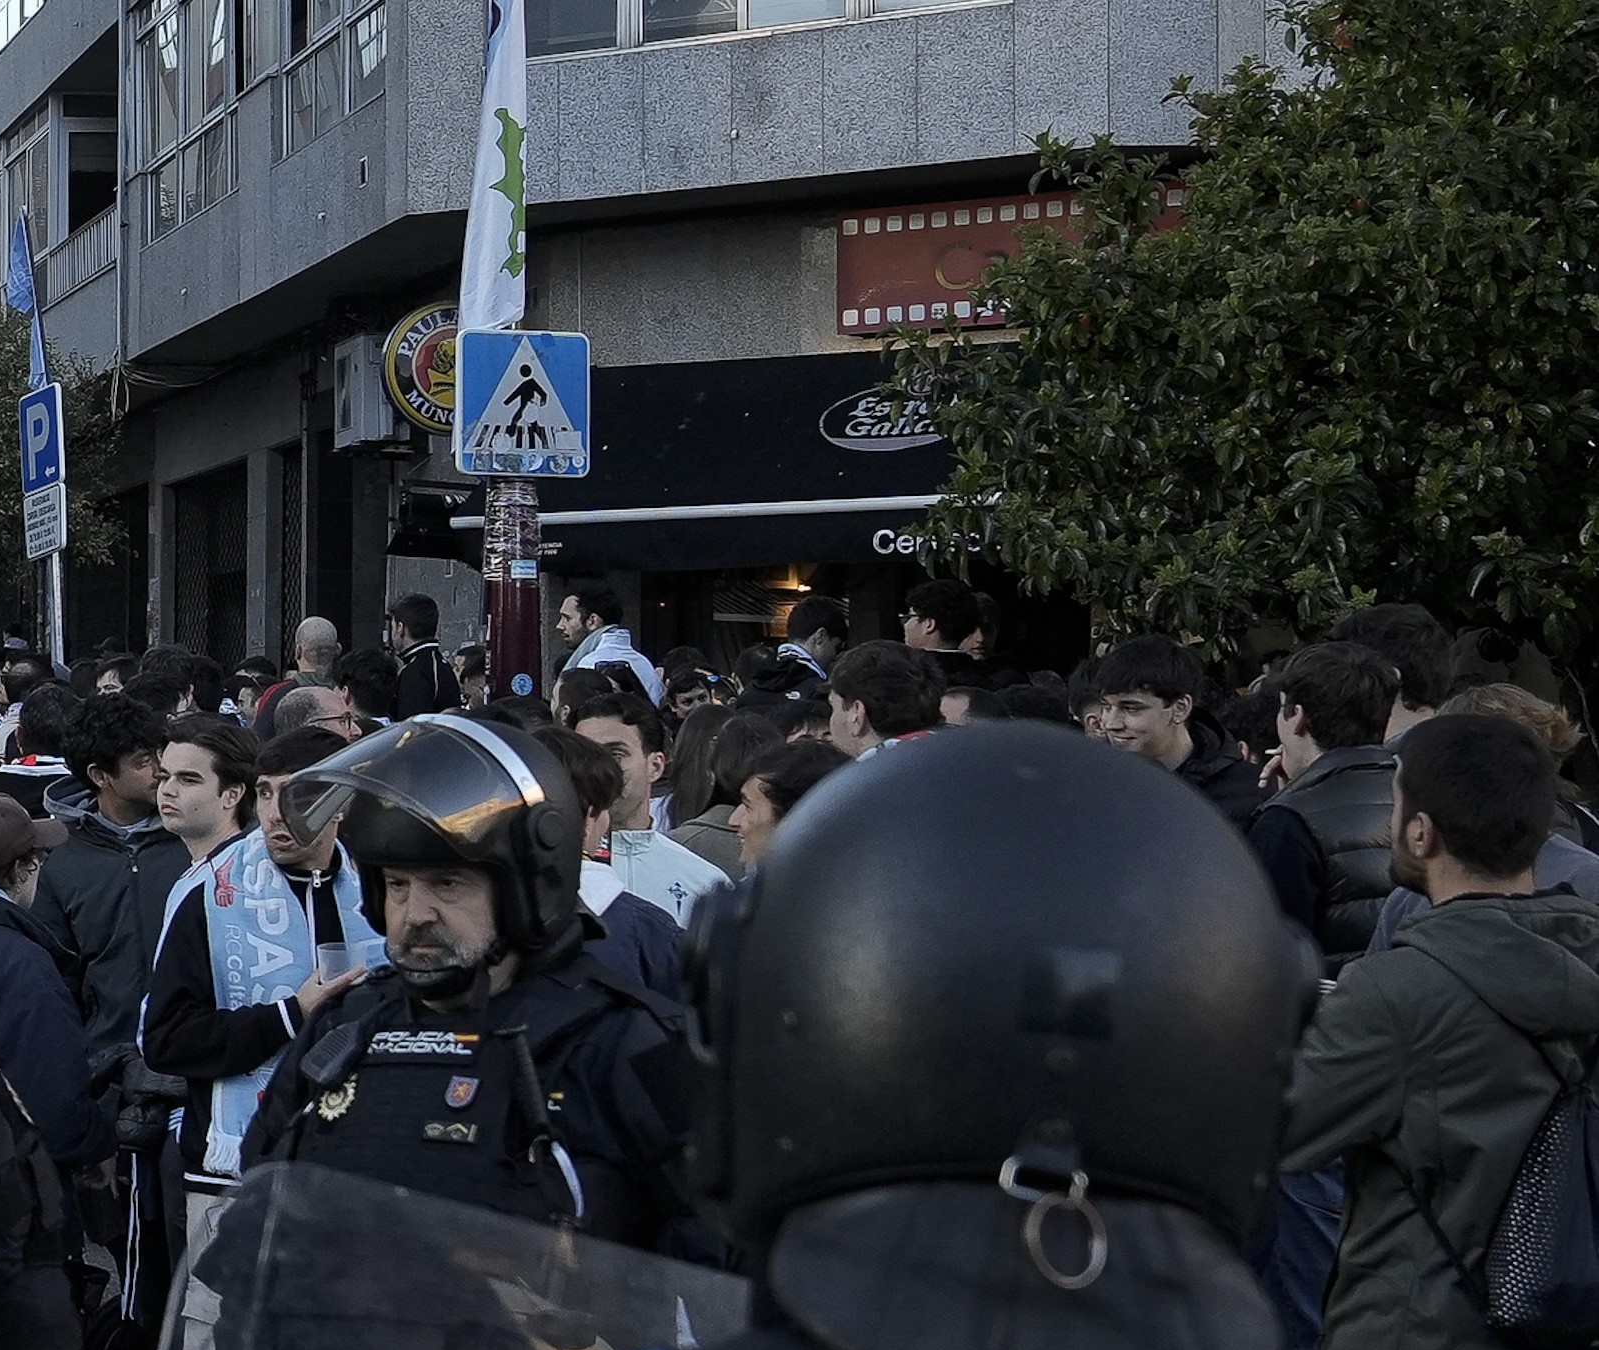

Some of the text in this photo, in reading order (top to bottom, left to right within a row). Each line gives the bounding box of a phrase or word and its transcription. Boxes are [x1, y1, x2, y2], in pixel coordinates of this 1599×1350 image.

[26, 402, 50, 481] P
[372, 1031, 457, 1042] POLICIA
[367, 1041, 473, 1055] NACIONAL
